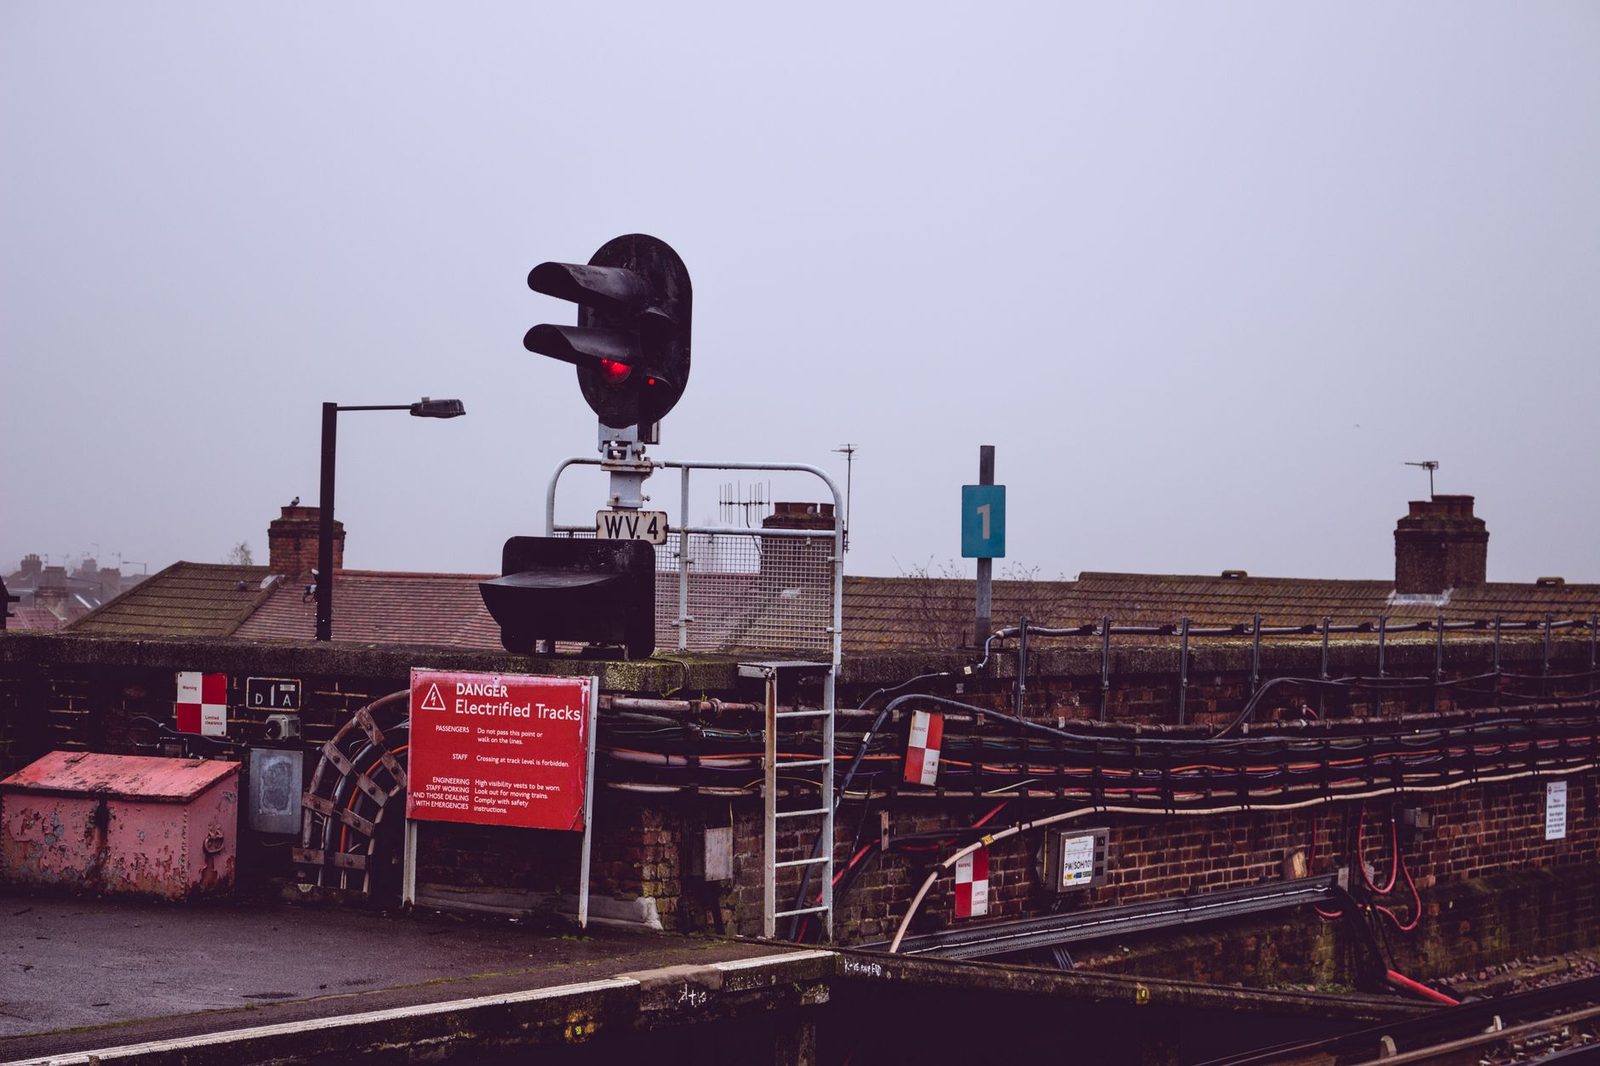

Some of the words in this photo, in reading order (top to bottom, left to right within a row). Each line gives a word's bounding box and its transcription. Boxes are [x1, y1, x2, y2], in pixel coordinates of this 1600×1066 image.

[976, 503, 991, 540] 1
[647, 516, 658, 540] 4
[456, 683, 509, 698] DANGER
[455, 699, 531, 718] Electrified
[535, 703, 581, 721] Tracks
[435, 725, 470, 733] PASSENGERS
[476, 755, 500, 764] Crossing
[542, 760, 570, 768] forbidden.
[432, 776, 470, 785] ENGINEERING
[474, 779, 488, 788] High
[488, 780, 512, 789] visibility
[442, 785, 470, 794] WORKING
[474, 787, 488, 795] Look
[509, 791, 531, 800] moving
[426, 792, 444, 800] THOSE
[445, 793, 470, 802] DEALING
[474, 796, 496, 806] Comply
[511, 799, 529, 808] safety
[415, 799, 430, 807] WITH
[431, 801, 469, 810] EMERGENCIES
